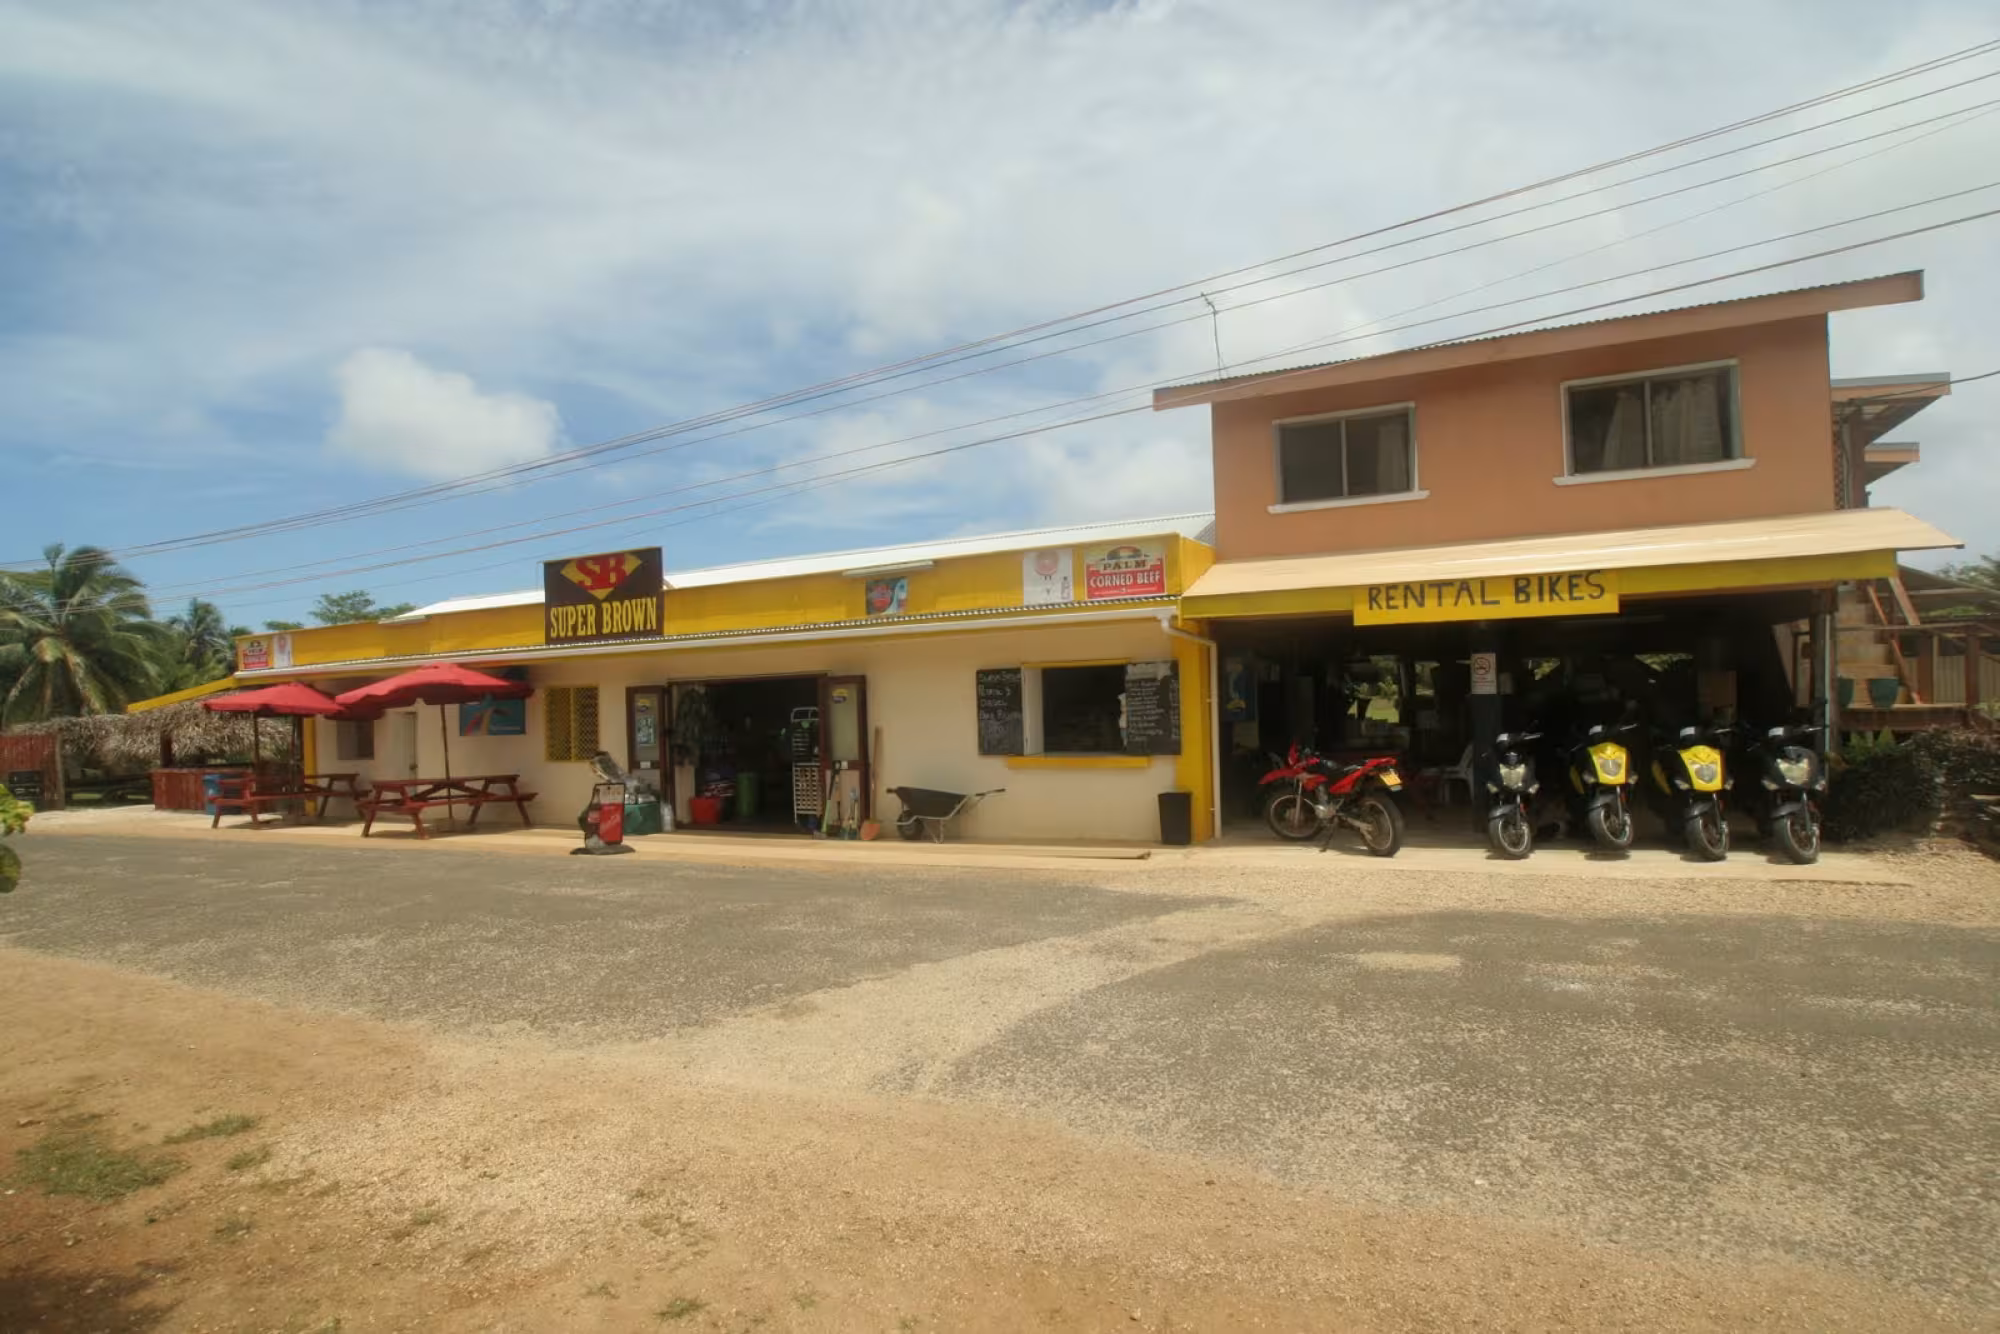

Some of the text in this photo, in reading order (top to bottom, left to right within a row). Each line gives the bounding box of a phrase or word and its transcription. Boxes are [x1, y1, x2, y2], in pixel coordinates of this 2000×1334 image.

[1090, 570, 1161, 588] CORNED BEEF
[1103, 559, 1147, 571] PALM
[1368, 570, 1606, 611] RENTAL BIKES
[550, 597, 657, 638] SUPER BROWN
